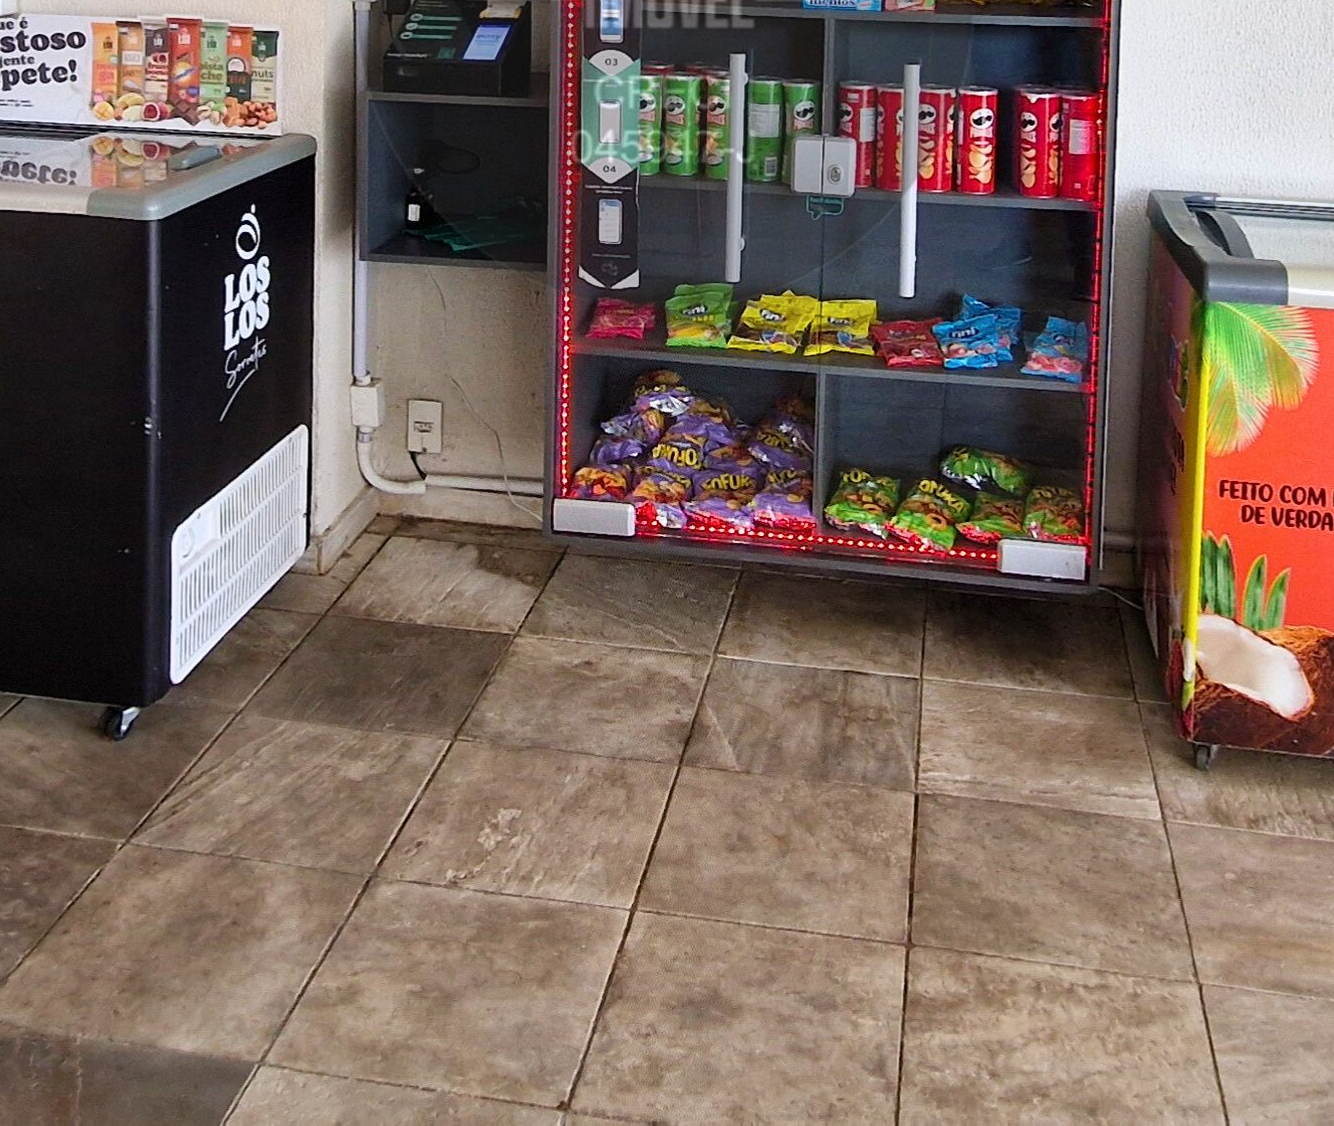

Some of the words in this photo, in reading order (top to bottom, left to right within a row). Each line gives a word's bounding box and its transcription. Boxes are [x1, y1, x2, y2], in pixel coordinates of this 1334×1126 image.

[20, 16, 28, 29] é
[604, 58, 618, 67] 03
[603, 165, 617, 174] 04
[224, 255, 271, 314] LOS
[224, 291, 270, 351] LOS
[225, 335, 267, 389] Sorvetes
[1219, 479, 1273, 503] FEITO
[1279, 485, 1327, 507] COM
[1241, 504, 1266, 524] DE
